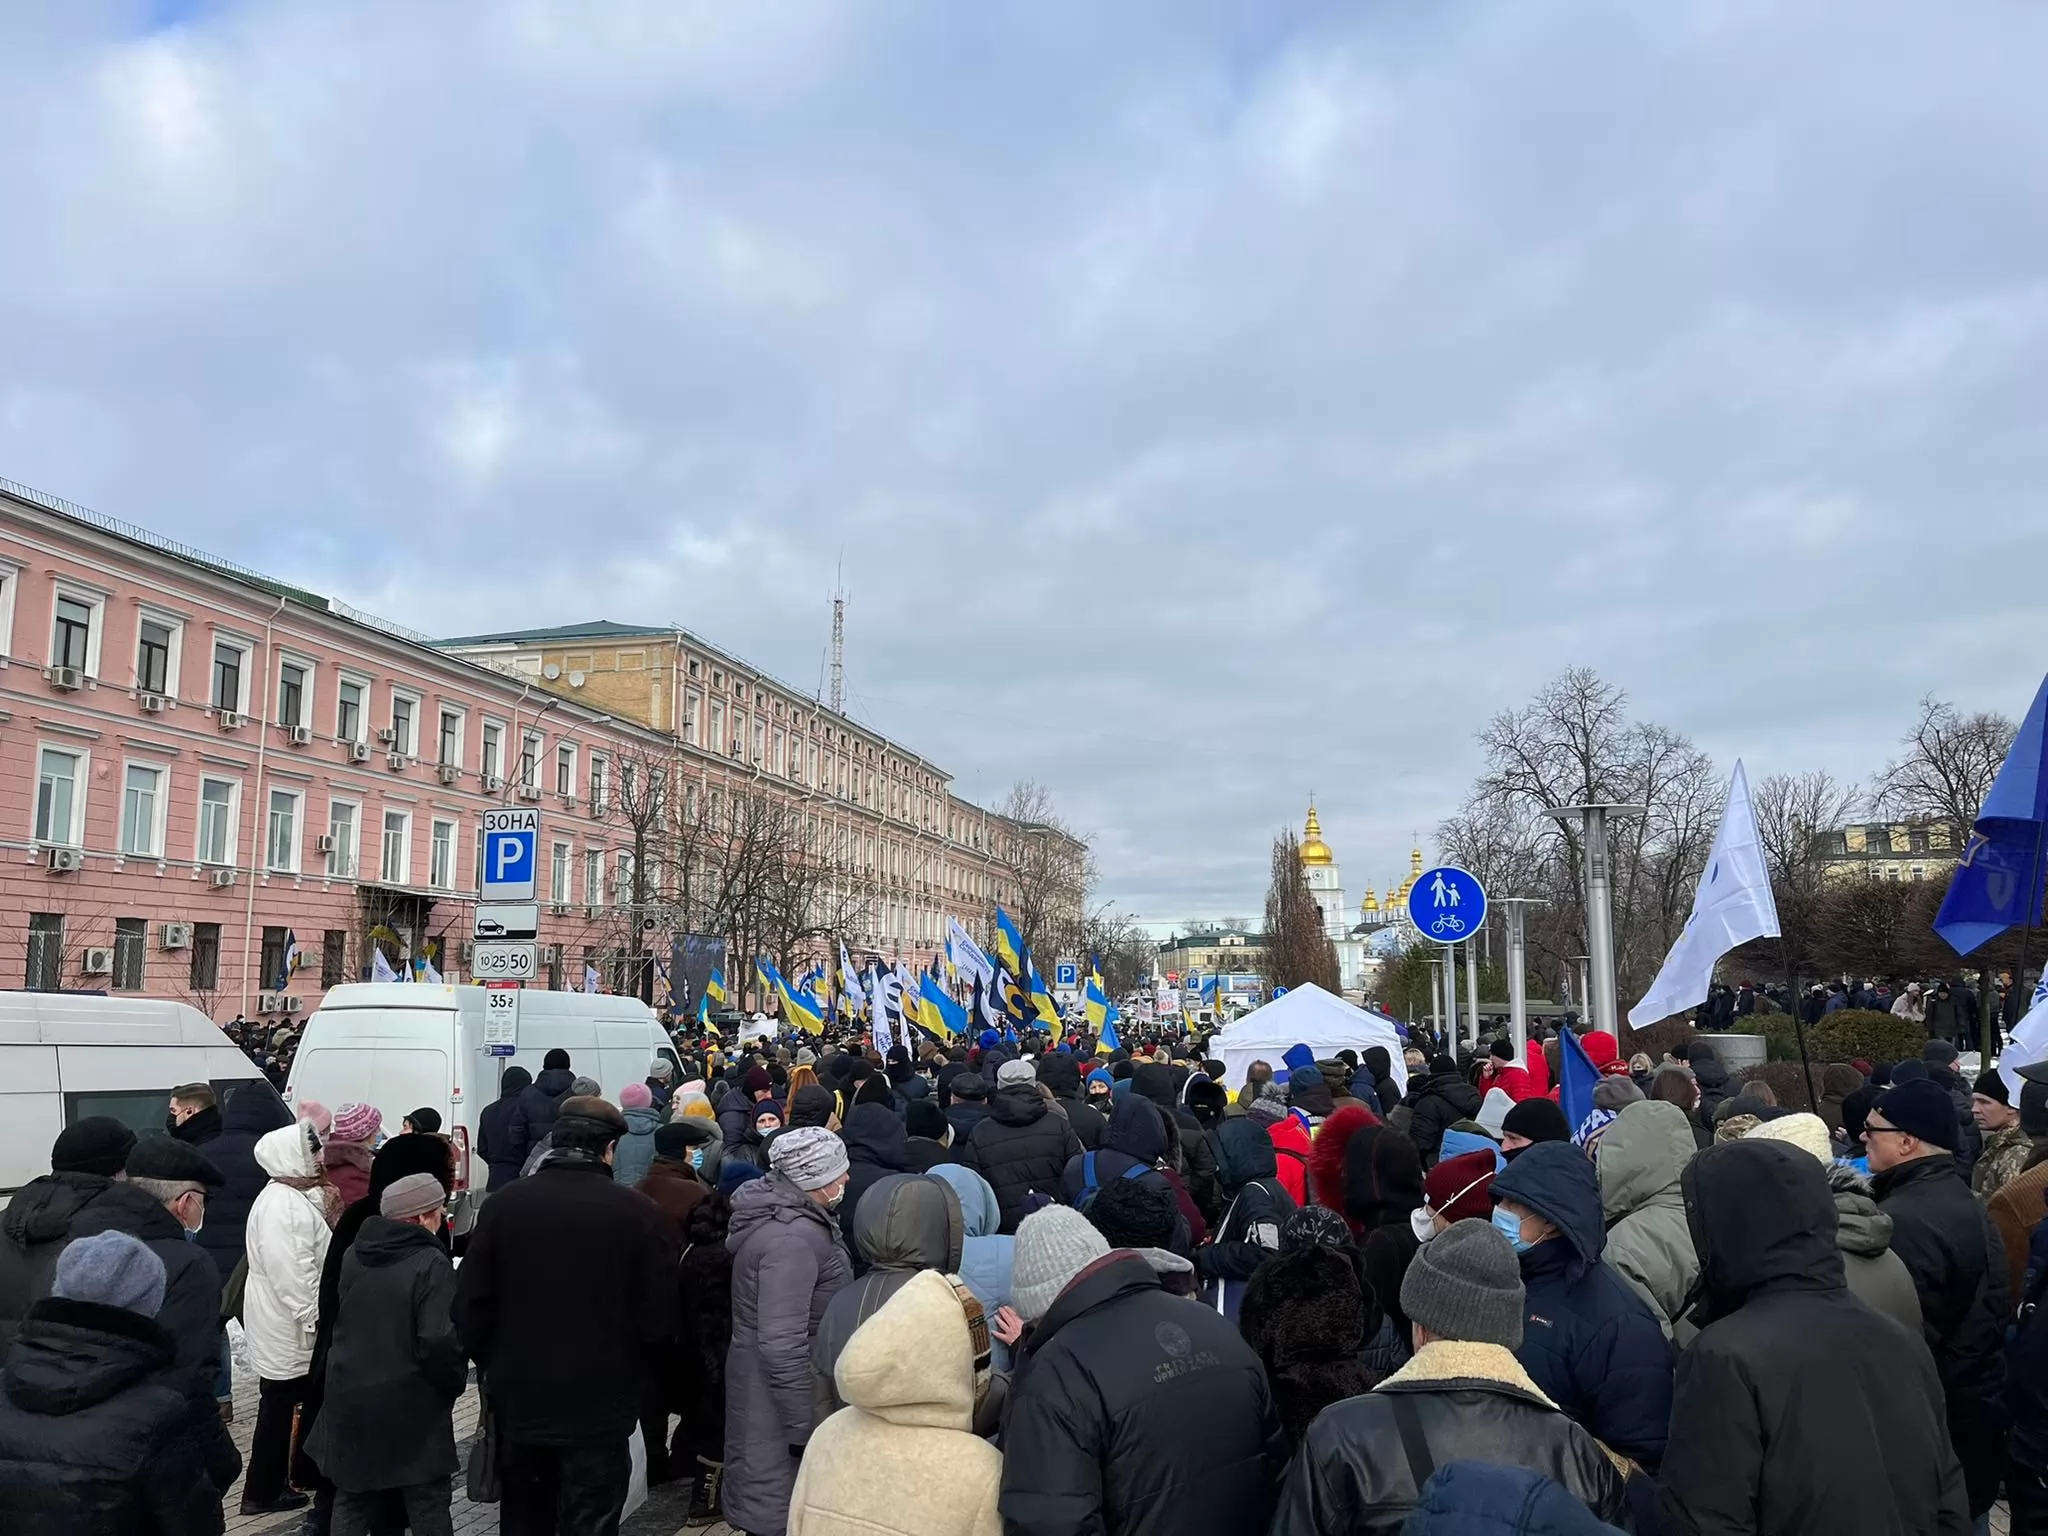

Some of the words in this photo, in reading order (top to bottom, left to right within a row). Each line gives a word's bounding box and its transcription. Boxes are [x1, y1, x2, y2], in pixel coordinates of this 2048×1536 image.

[485, 813, 536, 831] ЗОНА
[496, 837, 524, 880] P
[480, 956, 490, 968] 10
[492, 955, 506, 968] 25
[510, 953, 528, 969] 50
[1061, 967, 1072, 982] P
[490, 994, 507, 1008] 35
